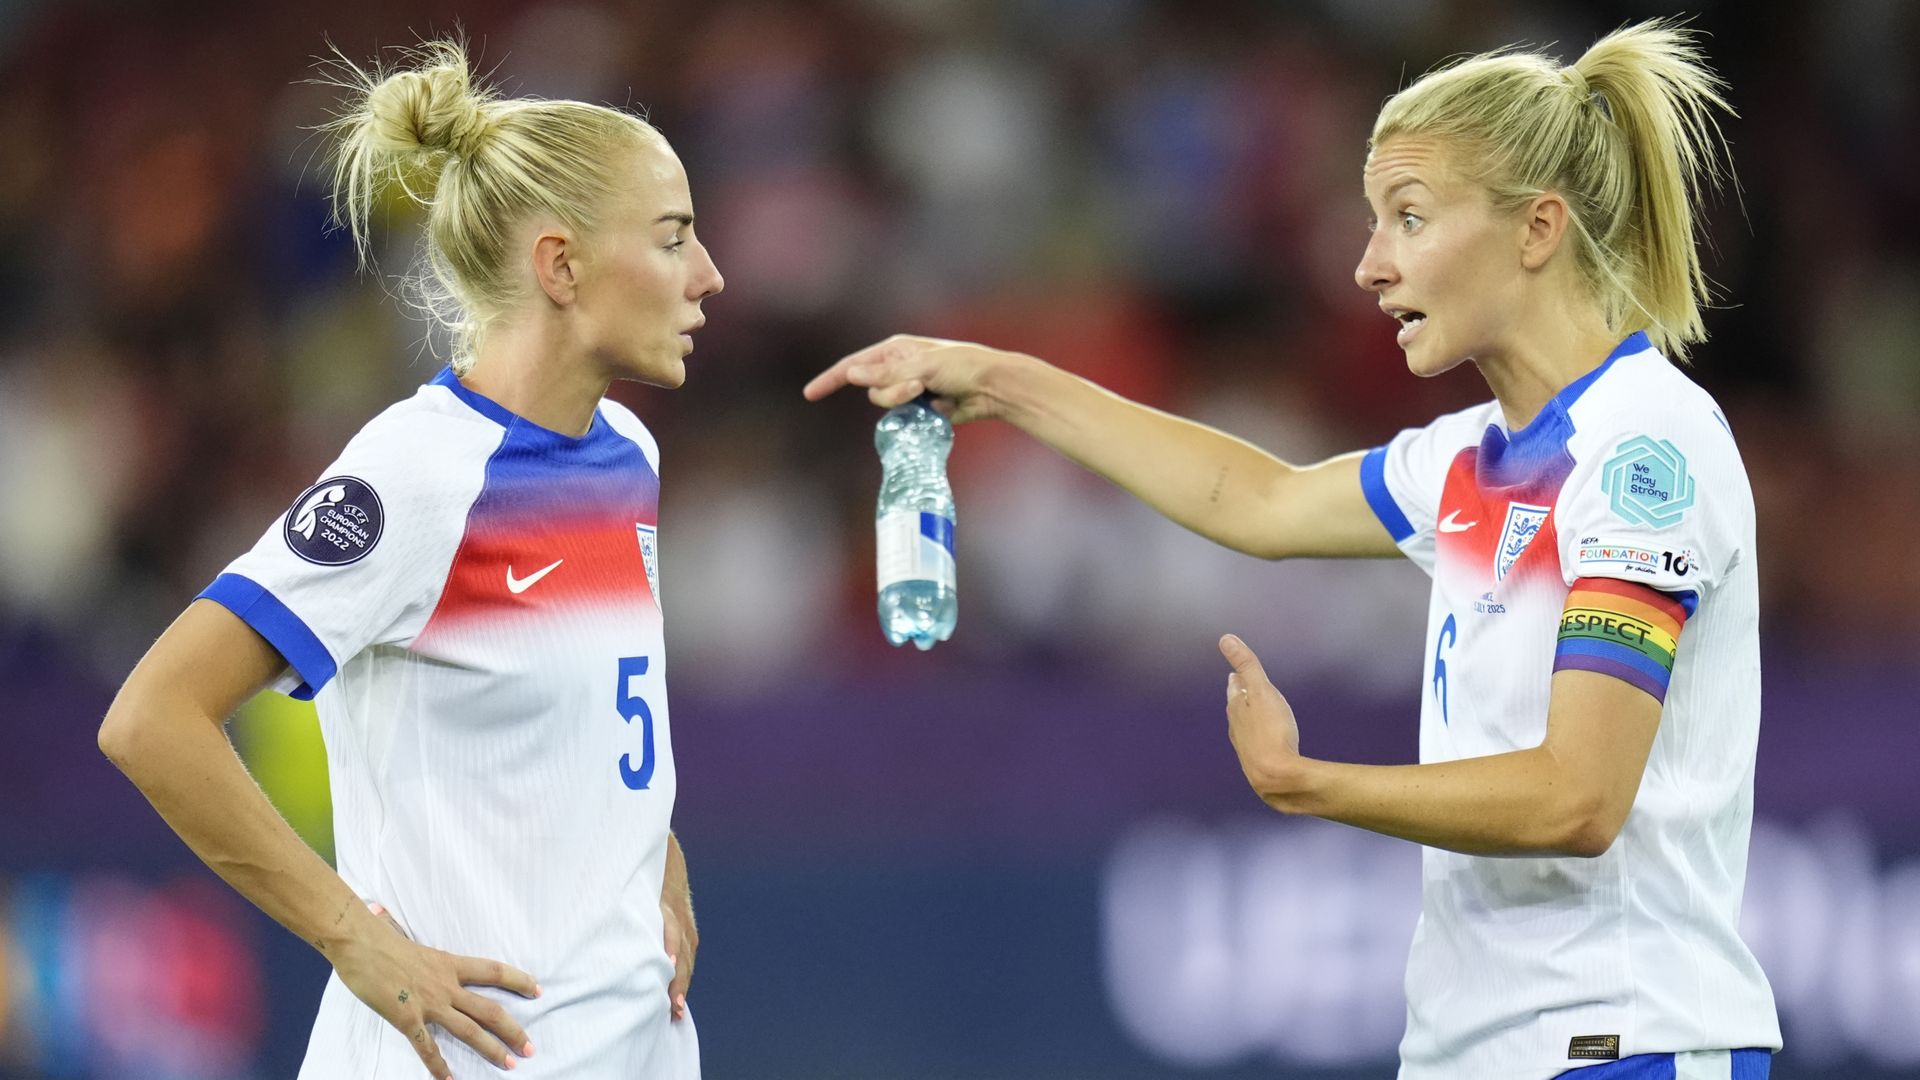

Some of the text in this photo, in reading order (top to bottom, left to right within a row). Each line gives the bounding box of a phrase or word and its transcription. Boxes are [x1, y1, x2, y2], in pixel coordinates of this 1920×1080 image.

[1633, 463, 1650, 473] We
[1631, 474, 1656, 488] Play
[1630, 484, 1668, 501] Strong
[327, 509, 369, 540] EUROPEAN
[343, 506, 367, 524] UEFA
[320, 515, 365, 548] CHAMPIONS
[321, 529, 350, 551] 2022
[1580, 537, 1599, 545] UEFA
[1580, 548, 1689, 576] FOUNDATION 10
[1487, 604, 1506, 614] 2025
[1433, 613, 1457, 728] 6
[616, 656, 655, 790] 5
